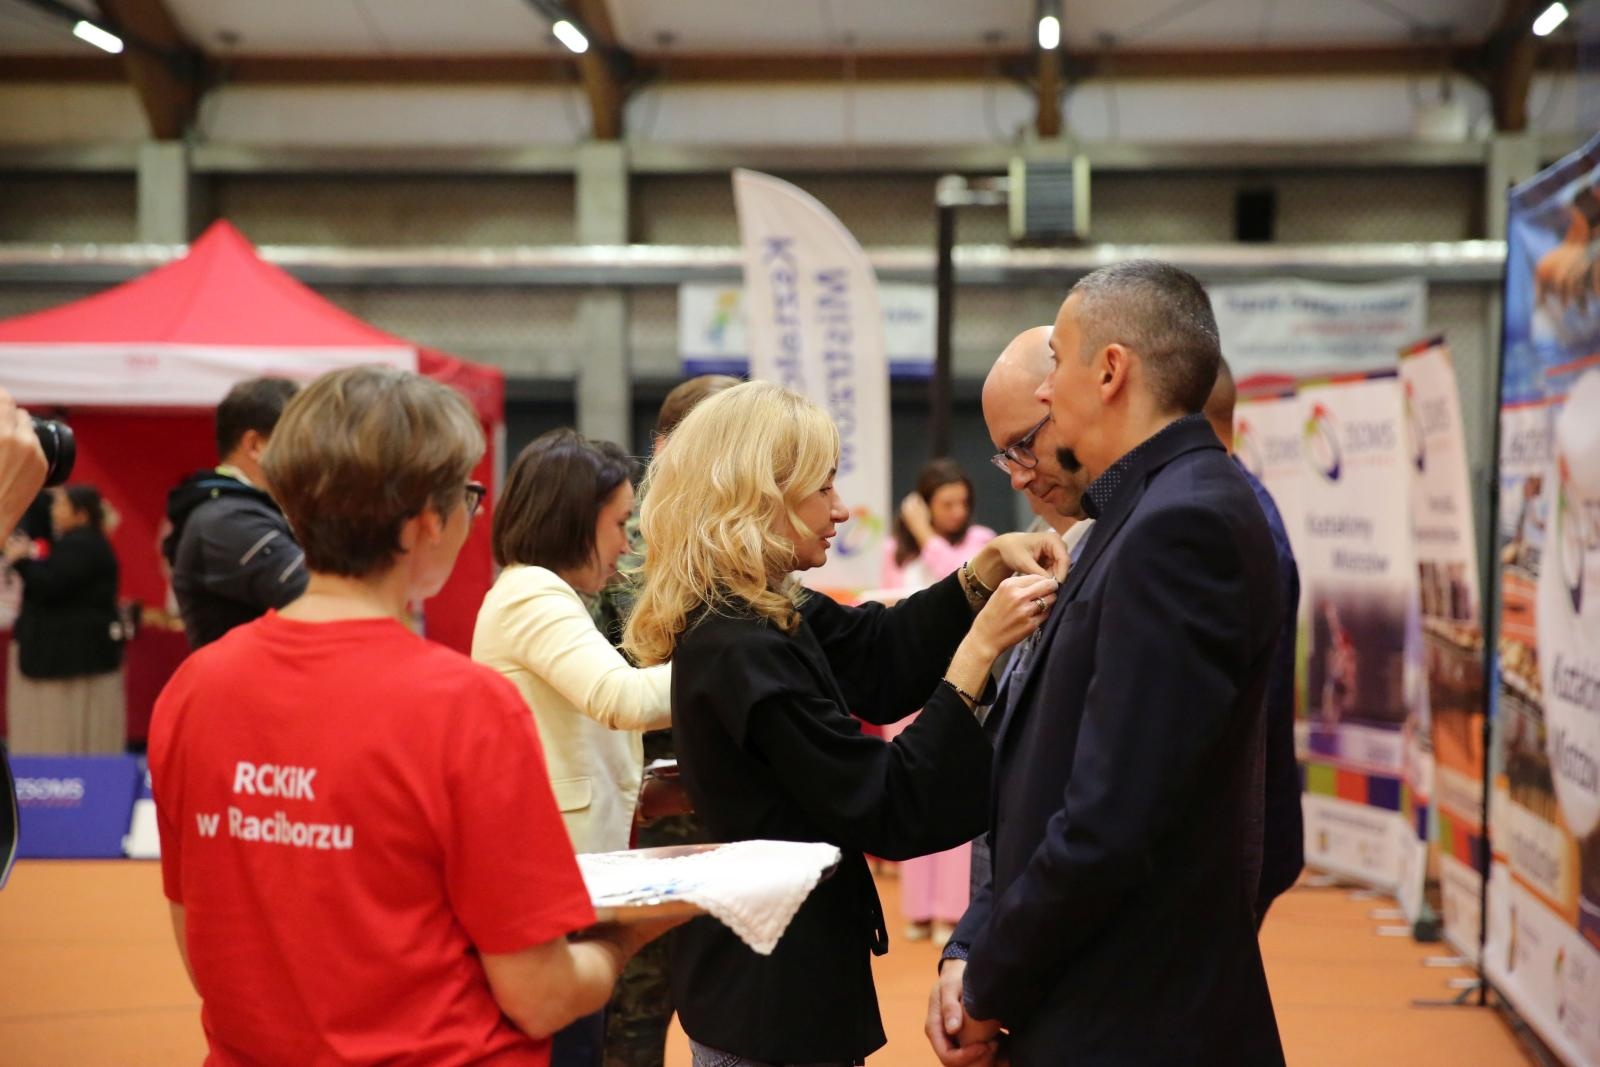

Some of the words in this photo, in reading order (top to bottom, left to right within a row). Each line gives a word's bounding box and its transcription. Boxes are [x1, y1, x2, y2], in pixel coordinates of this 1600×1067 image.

[233, 761, 316, 800] RCKiK
[196, 813, 219, 838] w
[228, 805, 353, 850] Raciborzu
